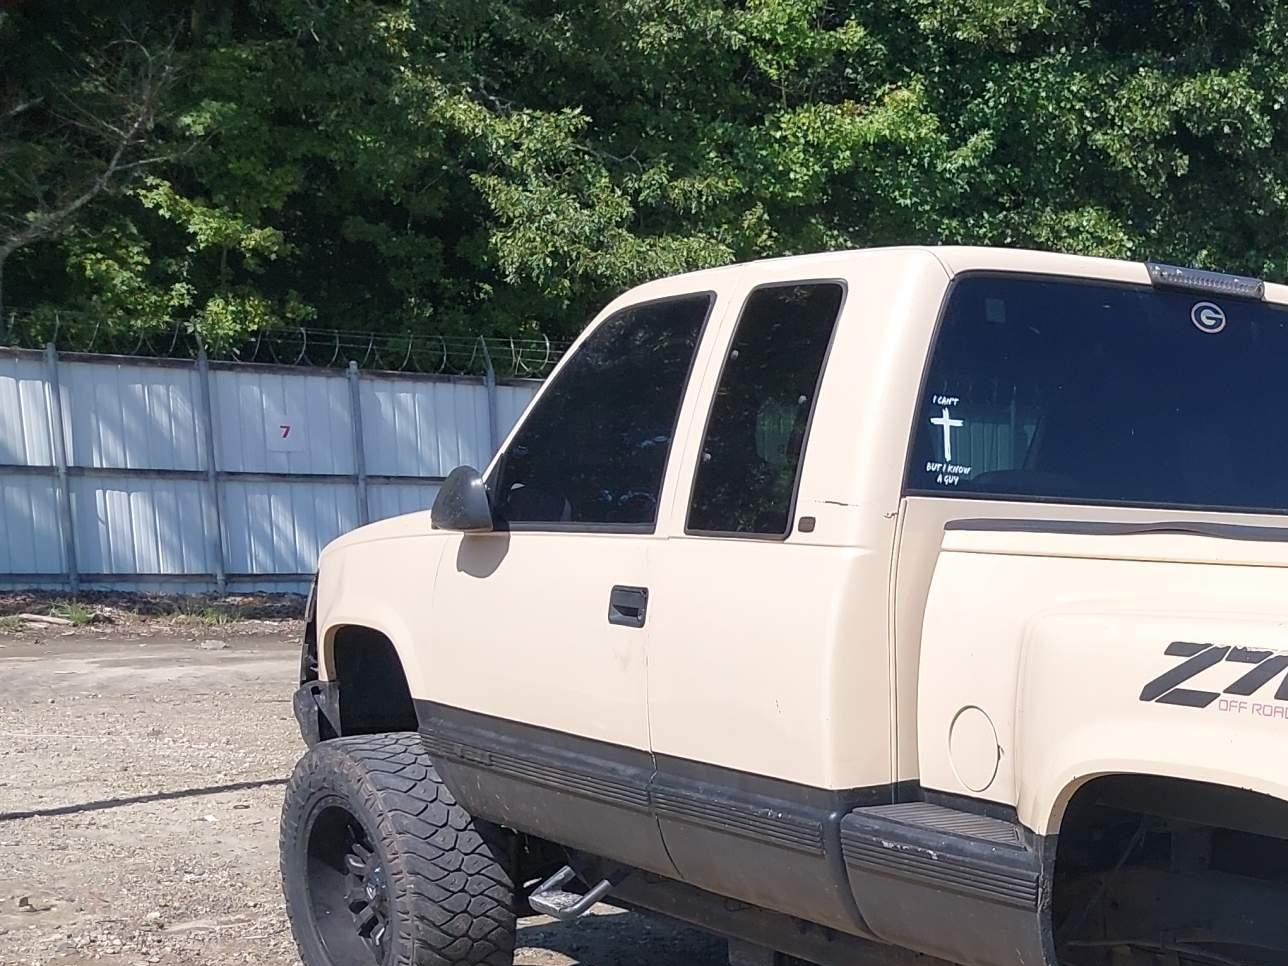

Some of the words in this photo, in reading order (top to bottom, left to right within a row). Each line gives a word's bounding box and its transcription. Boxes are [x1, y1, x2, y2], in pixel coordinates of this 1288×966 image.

[932, 395, 937, 404] I
[279, 425, 291, 438] 7
[926, 462, 942, 472] BUT
[942, 463, 947, 473] I
[947, 464, 971, 475] KNOW
[936, 473, 943, 484] A
[943, 474, 960, 486] GUY
[1218, 699, 1248, 713] OFF
